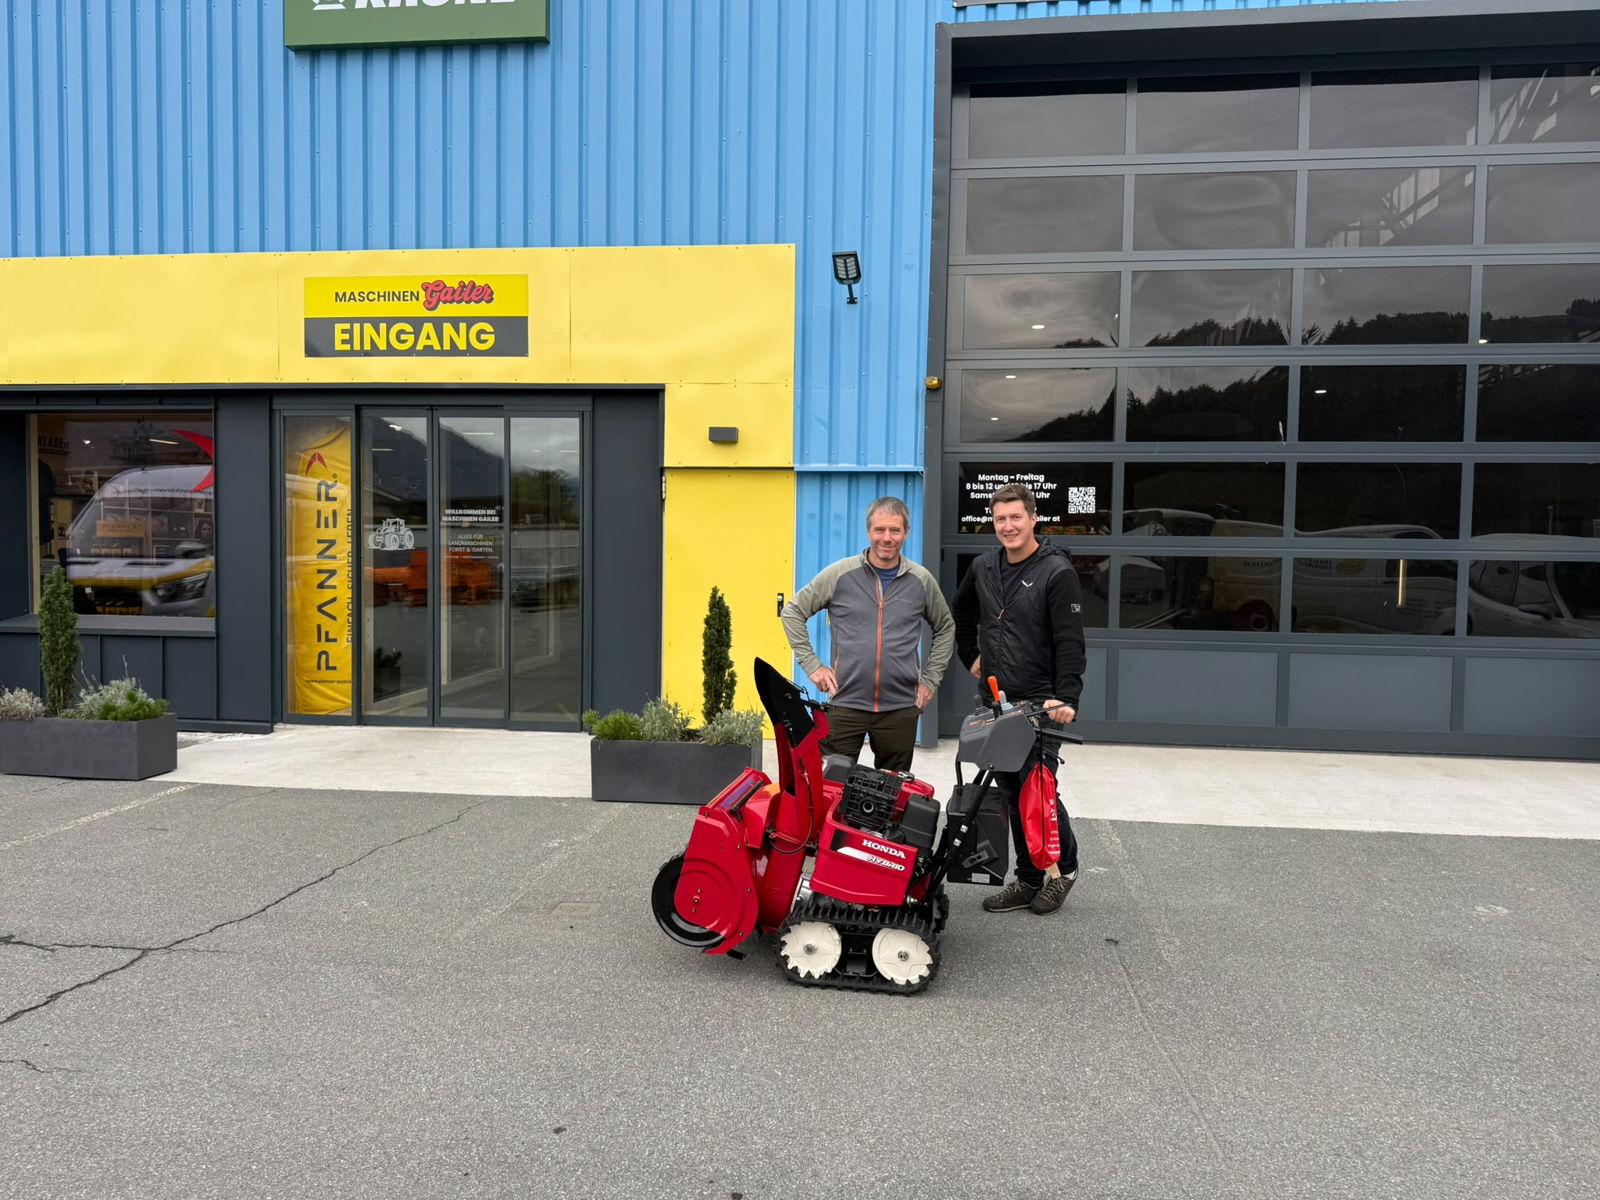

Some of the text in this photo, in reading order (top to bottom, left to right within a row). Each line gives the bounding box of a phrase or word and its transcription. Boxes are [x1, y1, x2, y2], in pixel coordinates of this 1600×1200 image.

[334, 280, 494, 311] MASCHINEN Gailer
[334, 322, 496, 351] EINGANG
[965, 482, 972, 490] 8
[972, 482, 985, 490] bis
[985, 482, 994, 490] 12
[1033, 482, 1042, 490] 17
[1042, 482, 1058, 490] Uhr
[978, 474, 1009, 483] Montag
[1016, 473, 1045, 483] Freitag
[1035, 491, 1051, 499] Uhr
[316, 480, 338, 670] PFANNER
[862, 839, 906, 859] HONDA
[867, 855, 906, 872] HYBRID
